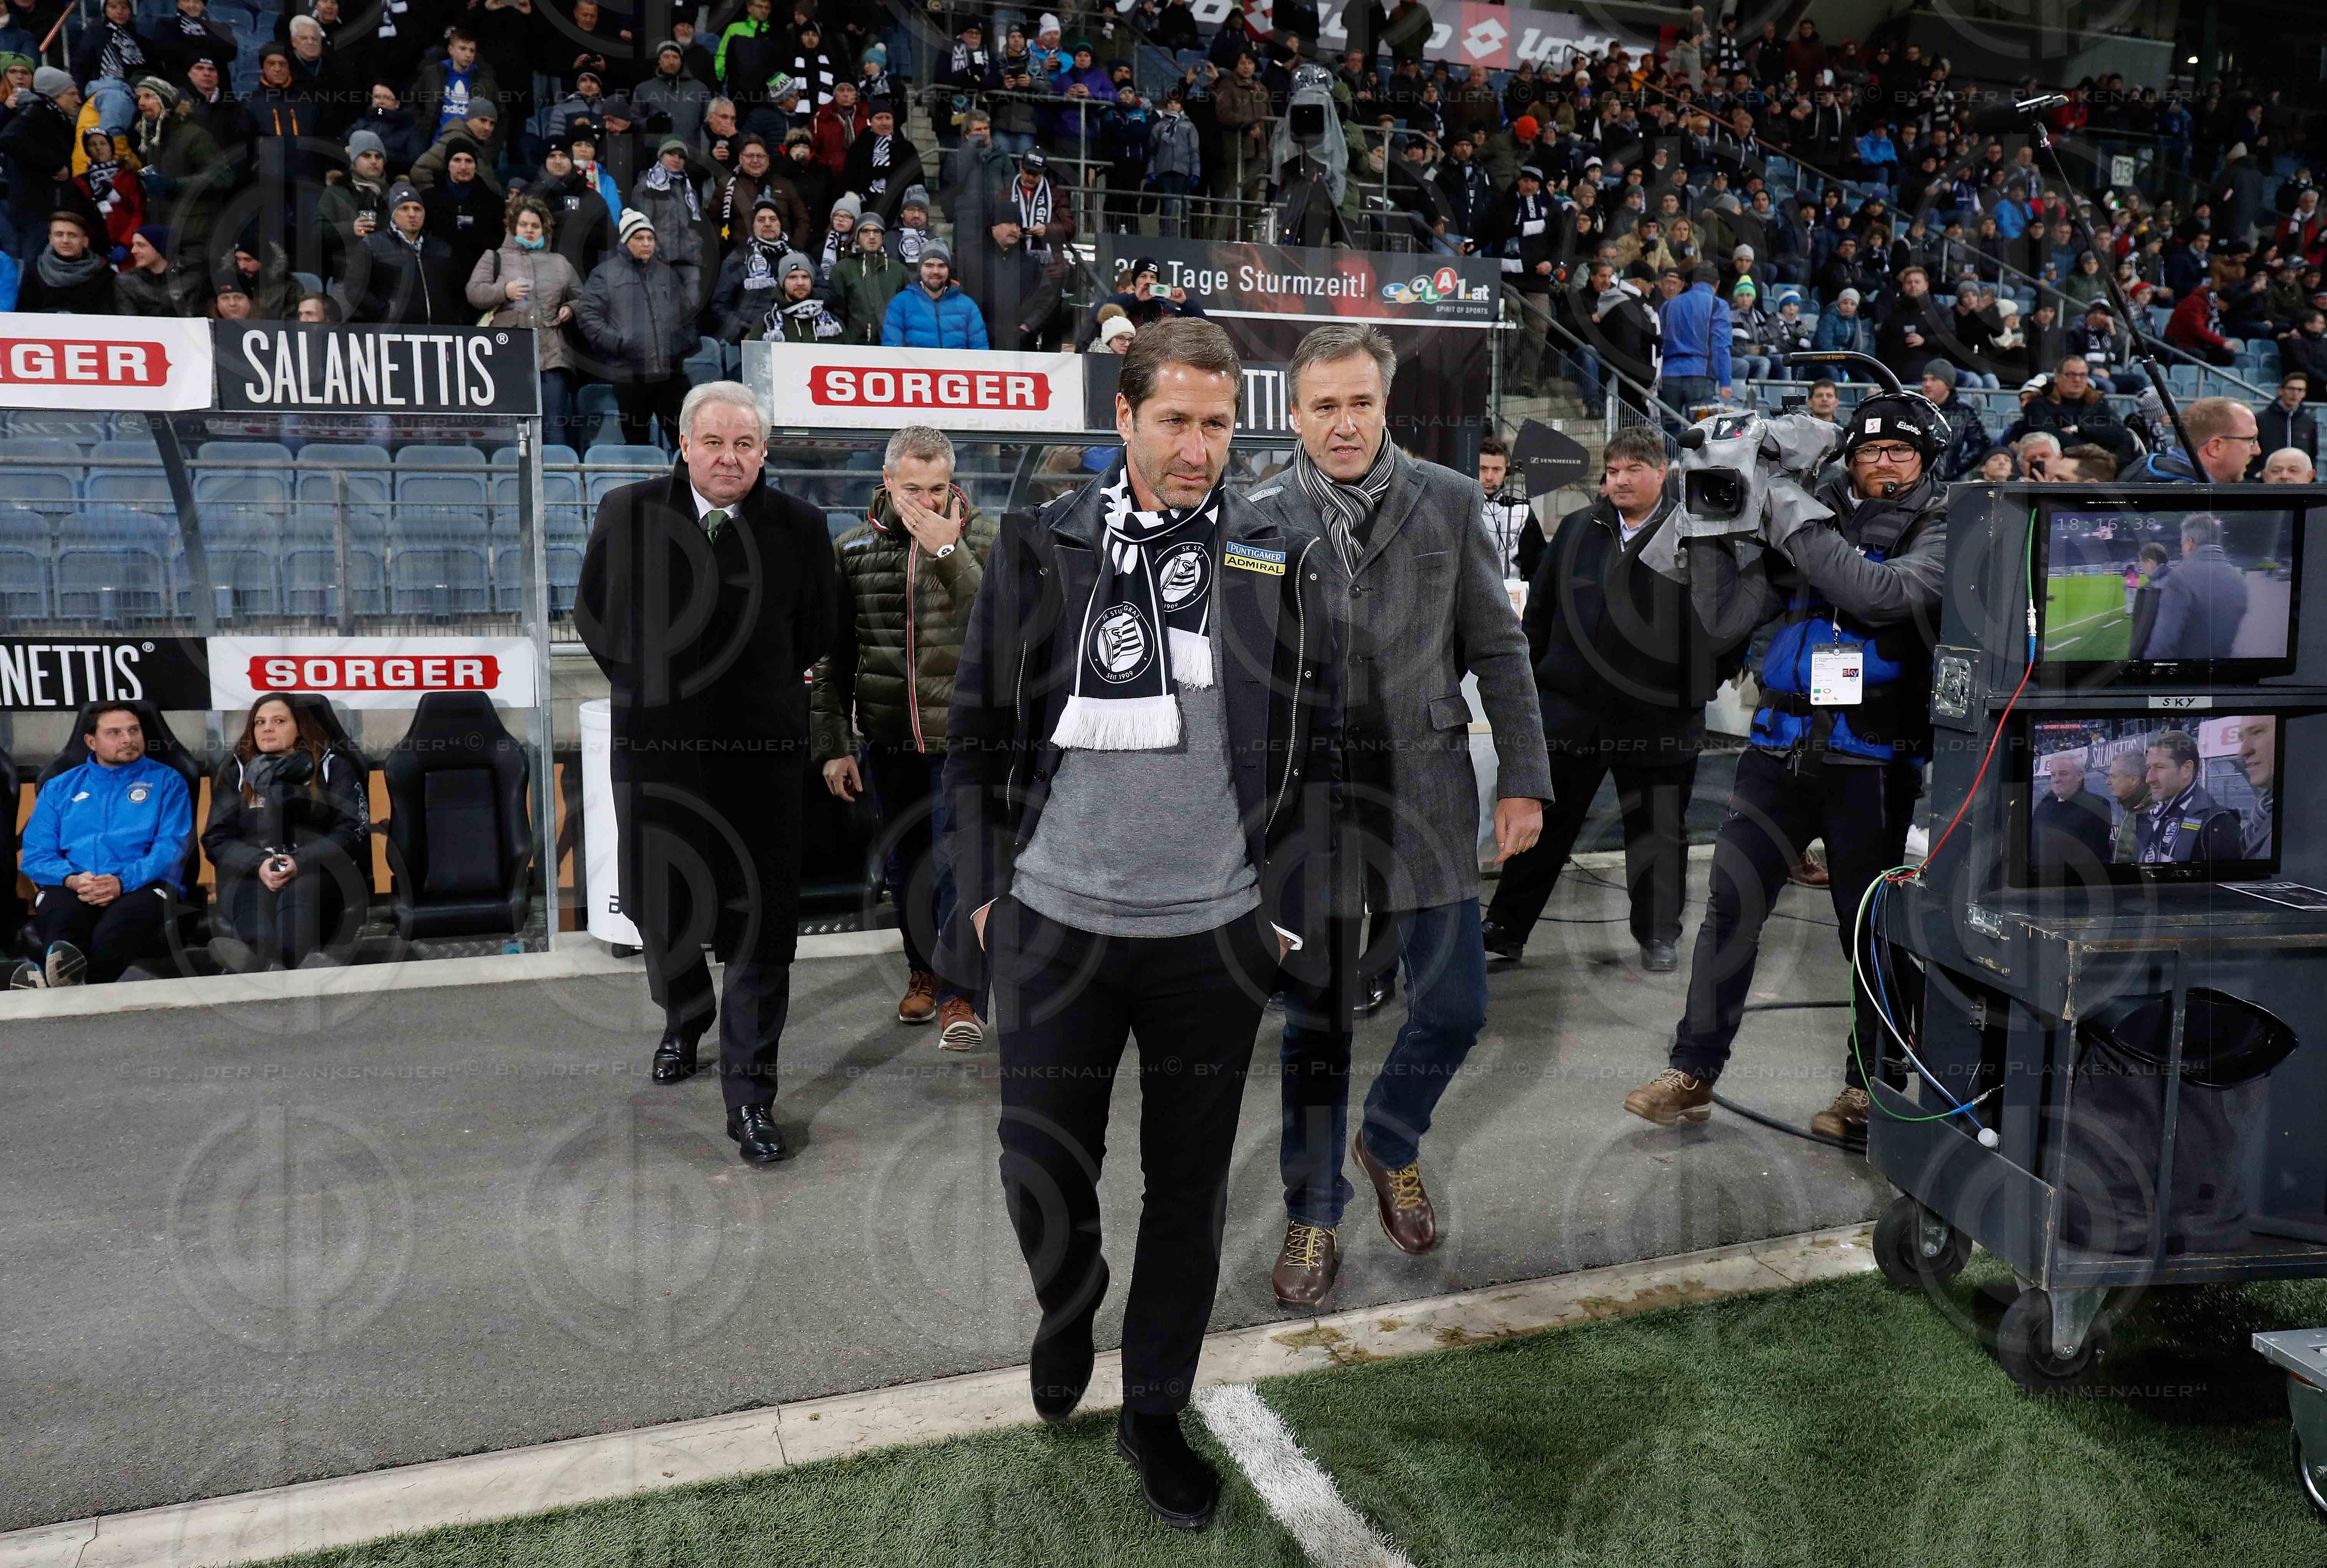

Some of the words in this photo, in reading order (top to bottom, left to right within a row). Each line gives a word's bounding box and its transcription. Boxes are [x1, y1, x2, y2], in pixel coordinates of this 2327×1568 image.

[1168, 261, 1229, 295] Tage
[1239, 265, 1366, 298] Sturmzeit!
[0, 344, 149, 381] GER
[826, 371, 1036, 406] SORGER
[1230, 544, 1281, 561] PUNTIGAMER
[1226, 556, 1284, 574] ADMIRAL
[1123, 605, 1140, 619] GRAZ
[265, 659, 484, 687] SORGER
[1119, 670, 1133, 680] 1909
